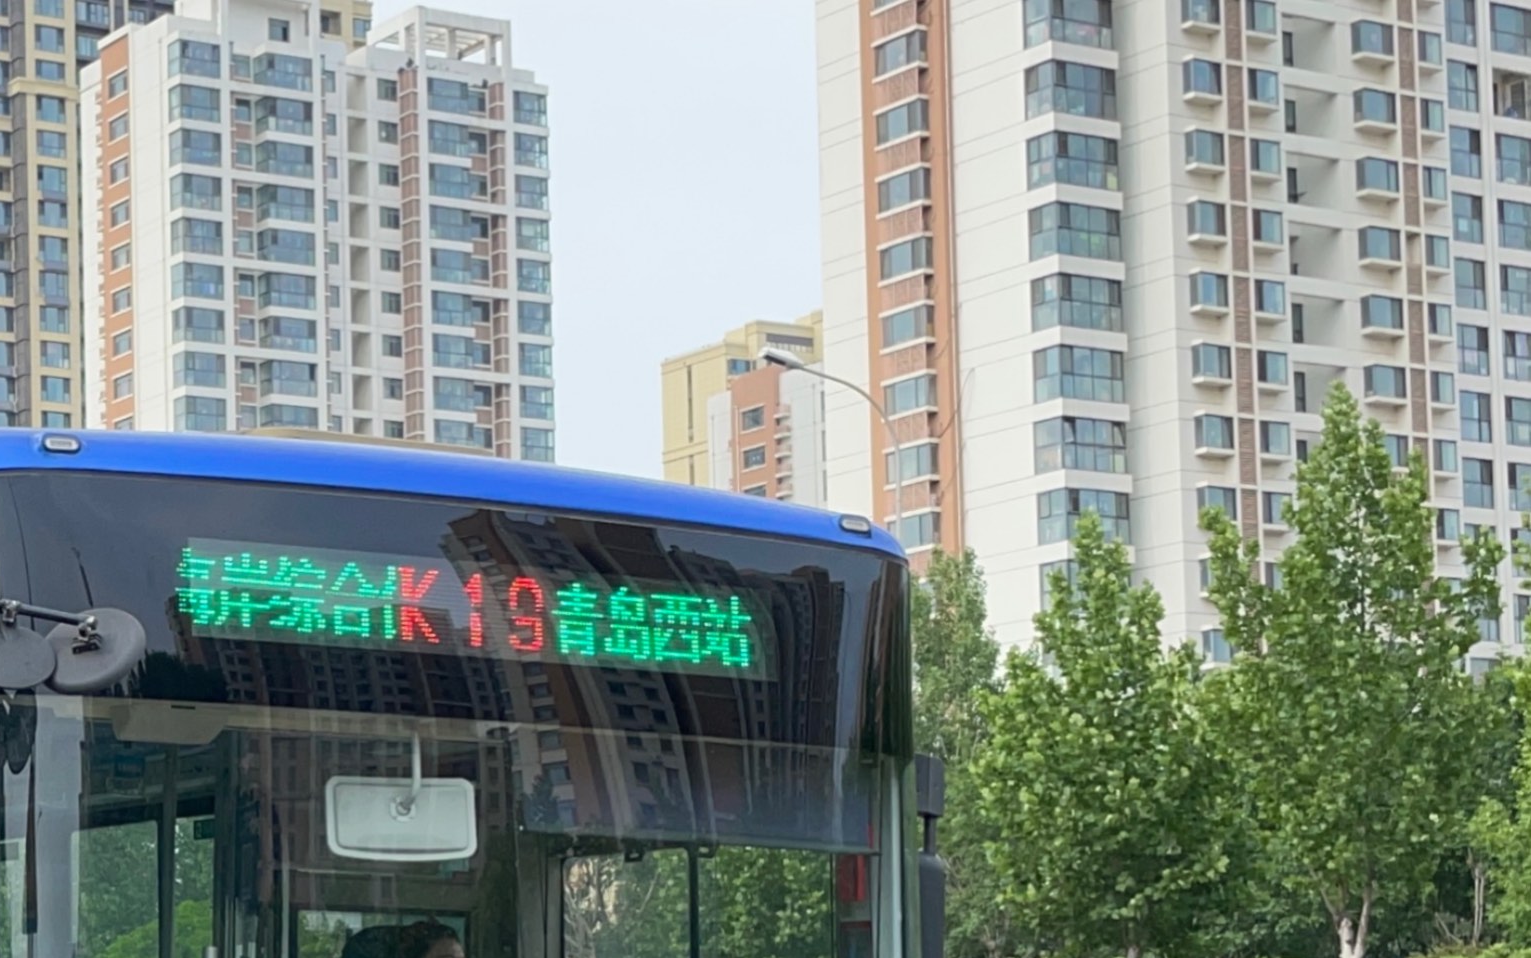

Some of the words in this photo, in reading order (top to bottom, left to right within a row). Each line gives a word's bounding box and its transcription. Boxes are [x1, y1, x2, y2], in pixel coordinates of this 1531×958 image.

[398, 565, 544, 652] K19
[551, 582, 751, 667] 青岛西站
